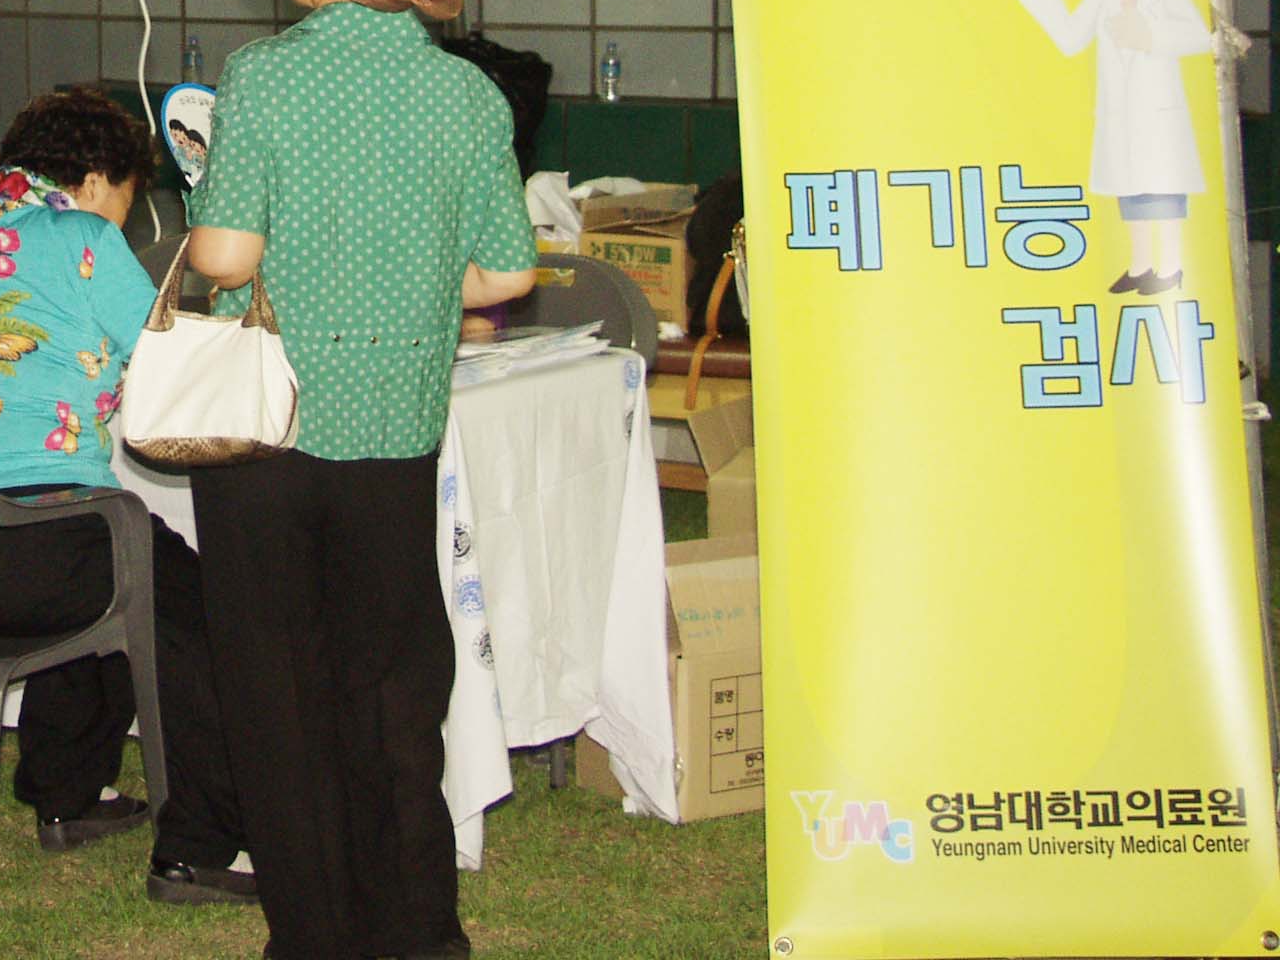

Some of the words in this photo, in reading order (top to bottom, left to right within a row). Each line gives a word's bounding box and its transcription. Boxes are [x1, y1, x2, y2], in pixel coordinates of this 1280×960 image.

[784, 164, 1090, 271] 폐기능
[1001, 300, 1215, 409] 검사
[790, 790, 915, 863] YUMC
[925, 787, 1248, 833] 영남대학교의료원
[932, 838, 1023, 861] Yeungnam
[1028, 836, 1116, 859] University
[1121, 834, 1188, 855] Medical
[1192, 833, 1251, 853] Center
